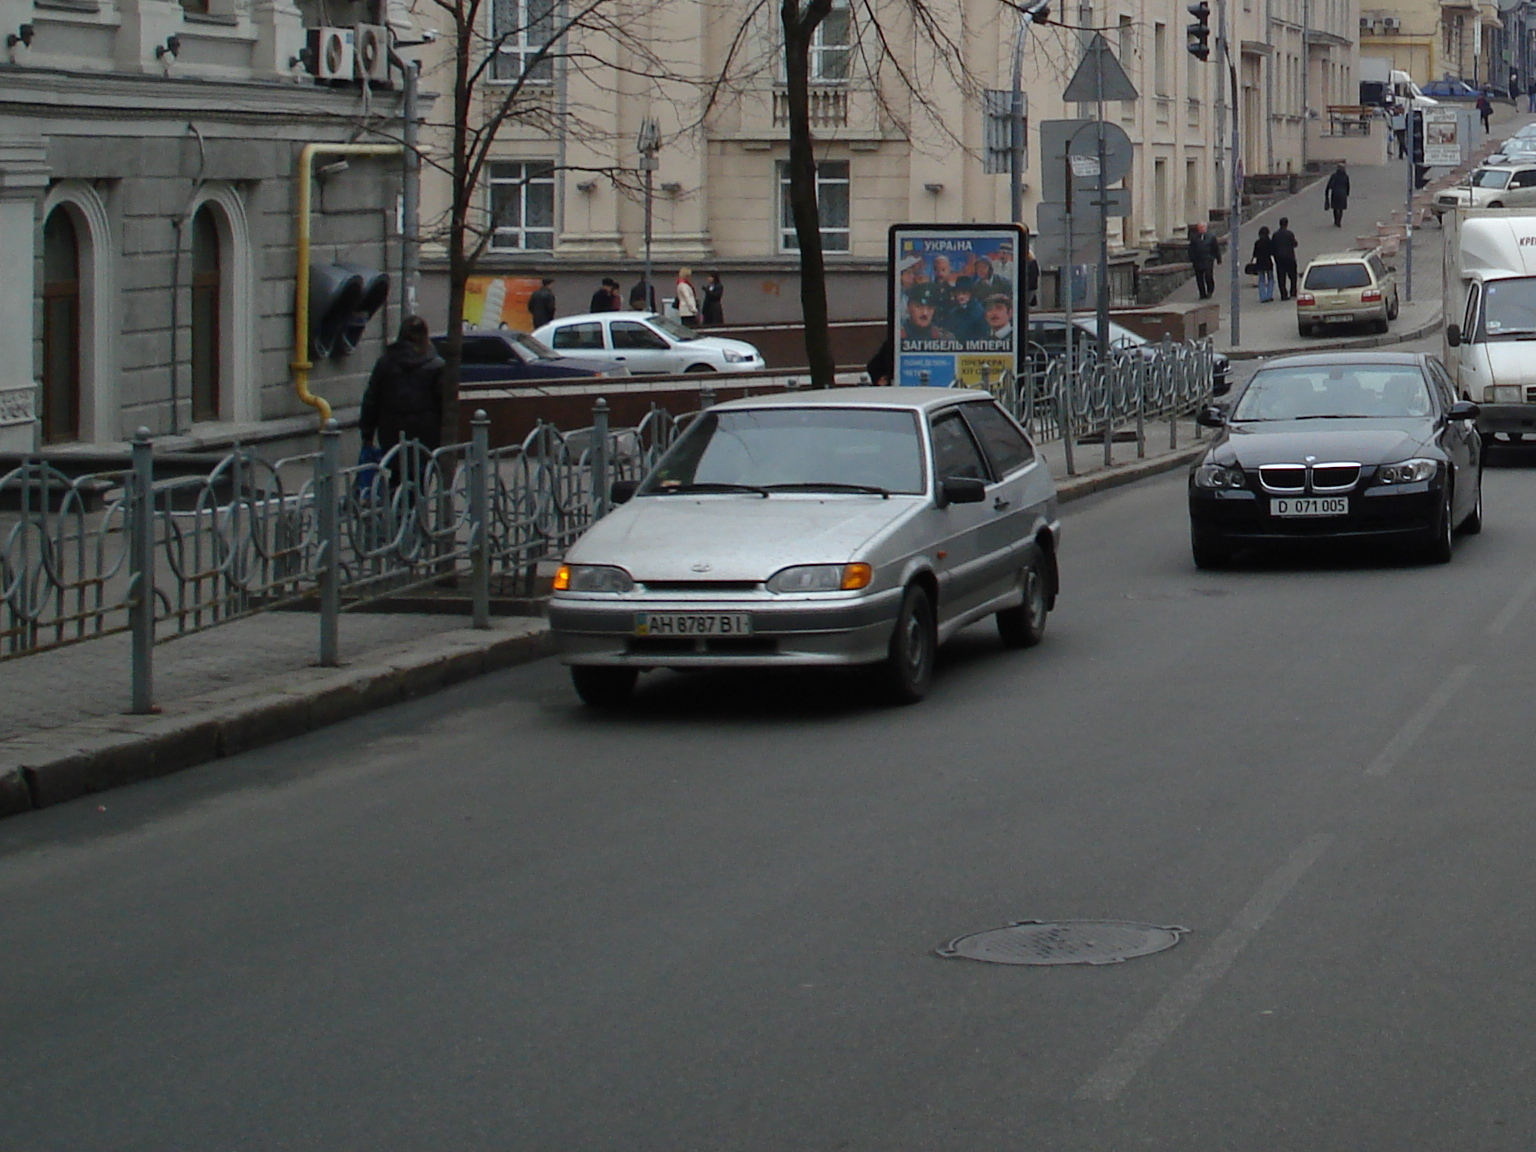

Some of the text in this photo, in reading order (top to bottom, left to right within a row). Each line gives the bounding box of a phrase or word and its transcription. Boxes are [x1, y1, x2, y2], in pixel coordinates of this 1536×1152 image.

[903, 339, 1011, 351] ЗАГИБЕЛЬ ІМПЕРІЇ
[1278, 499, 1345, 513] D 071 005
[650, 616, 740, 633] AH 8787 BI
